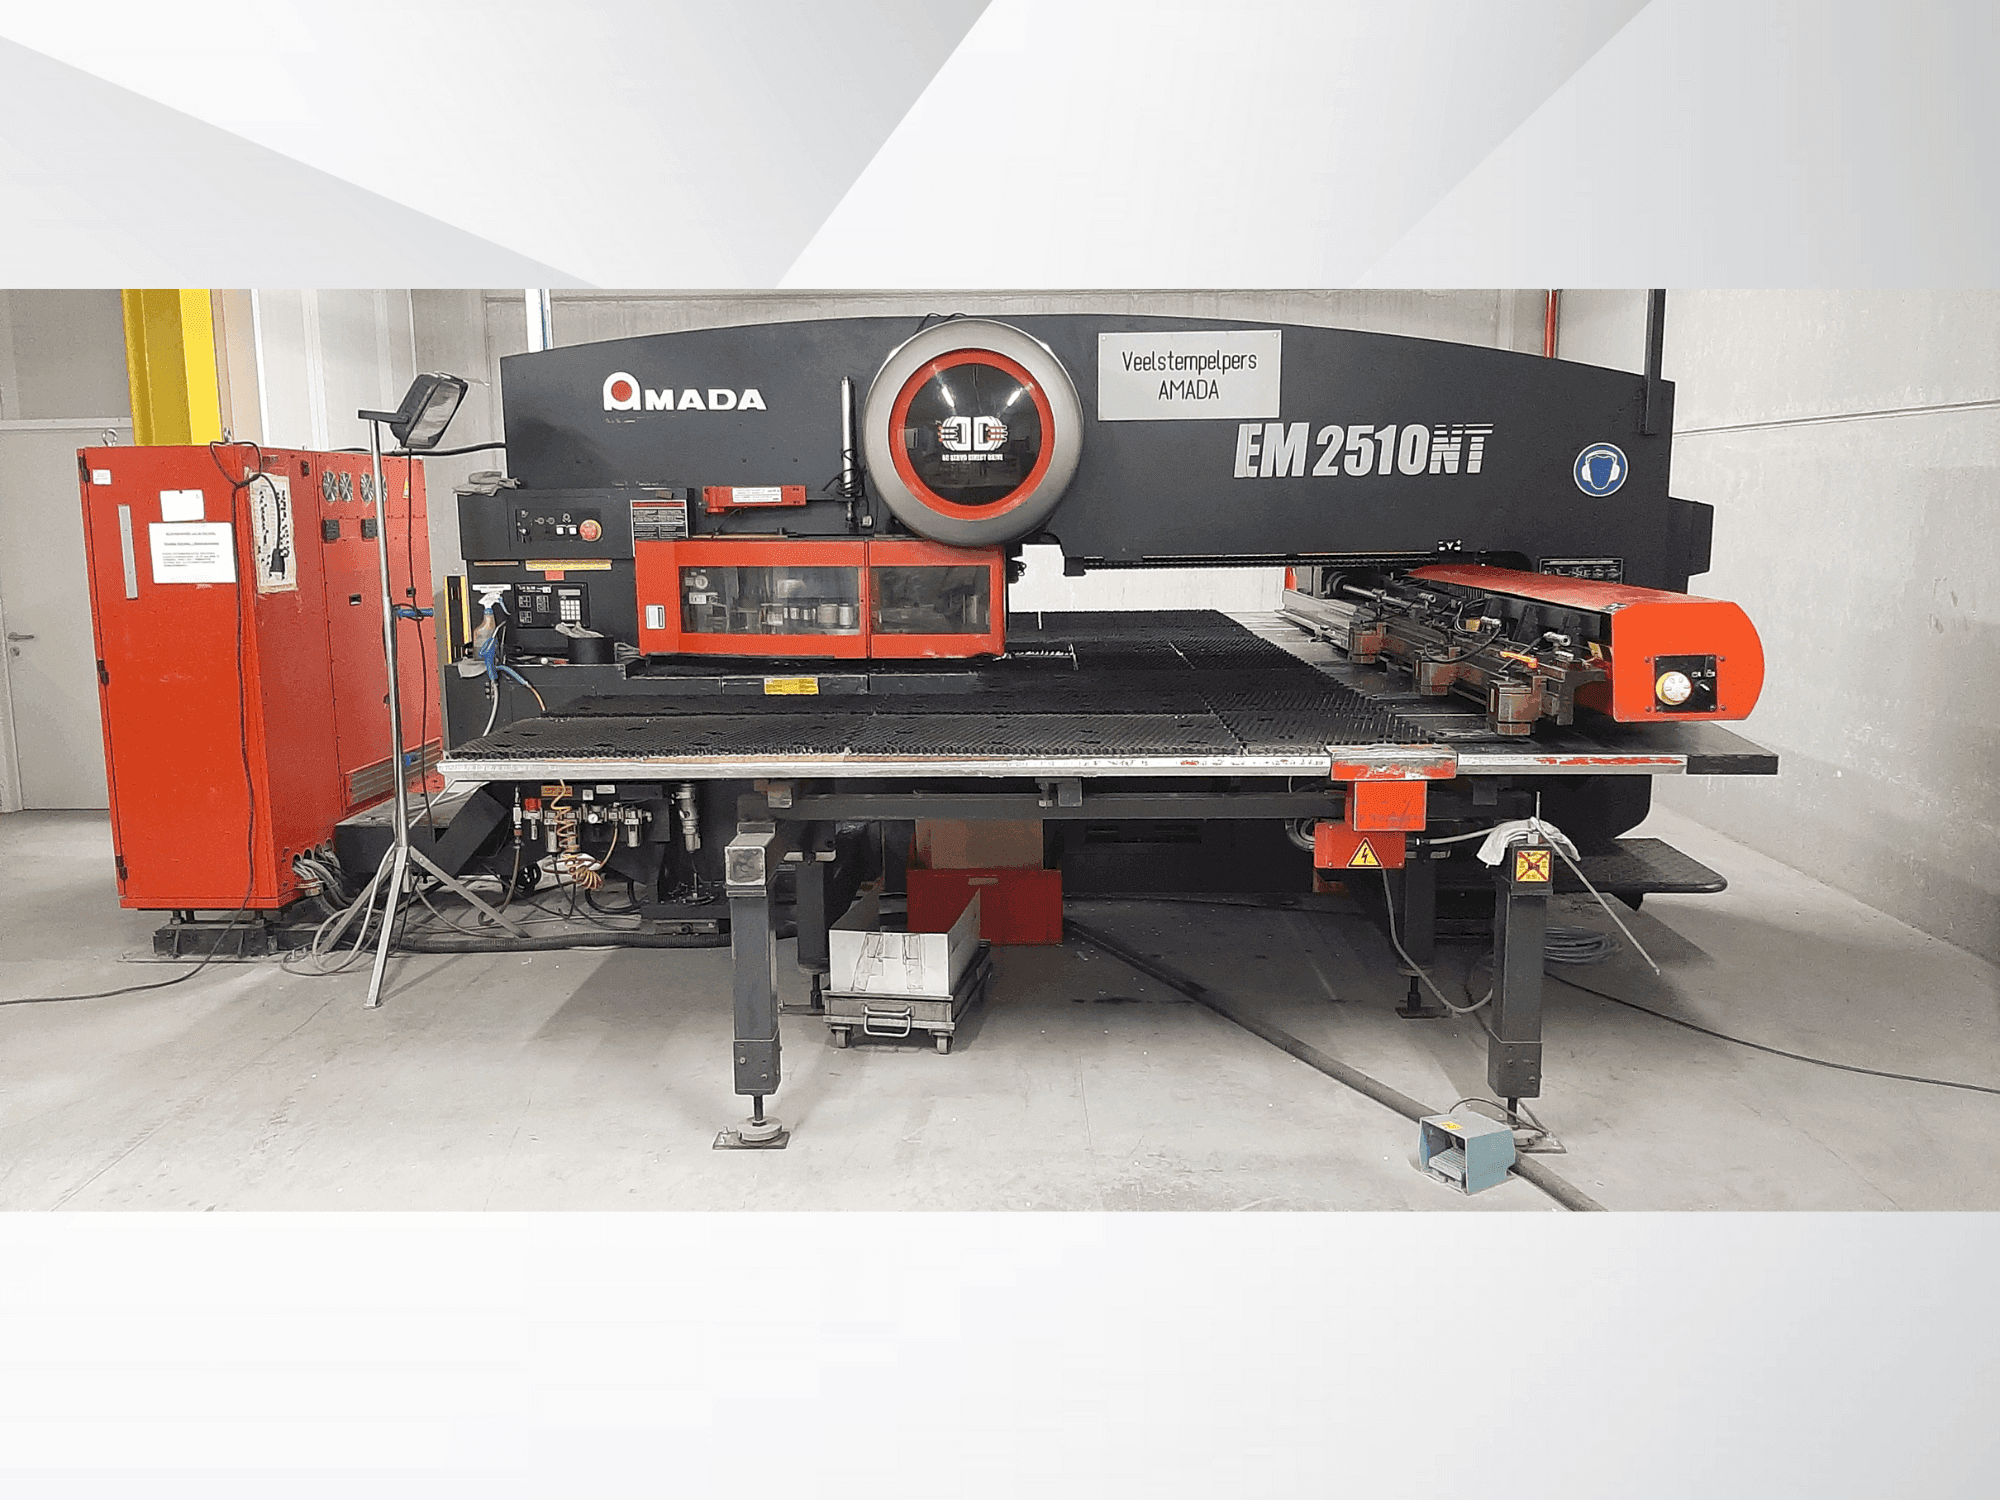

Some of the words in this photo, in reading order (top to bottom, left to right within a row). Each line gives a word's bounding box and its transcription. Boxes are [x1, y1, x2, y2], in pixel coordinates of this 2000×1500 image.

[1122, 350, 1257, 375] Veelstempelpers
[603, 372, 767, 411] AMADA
[1159, 379, 1219, 400] AMADA
